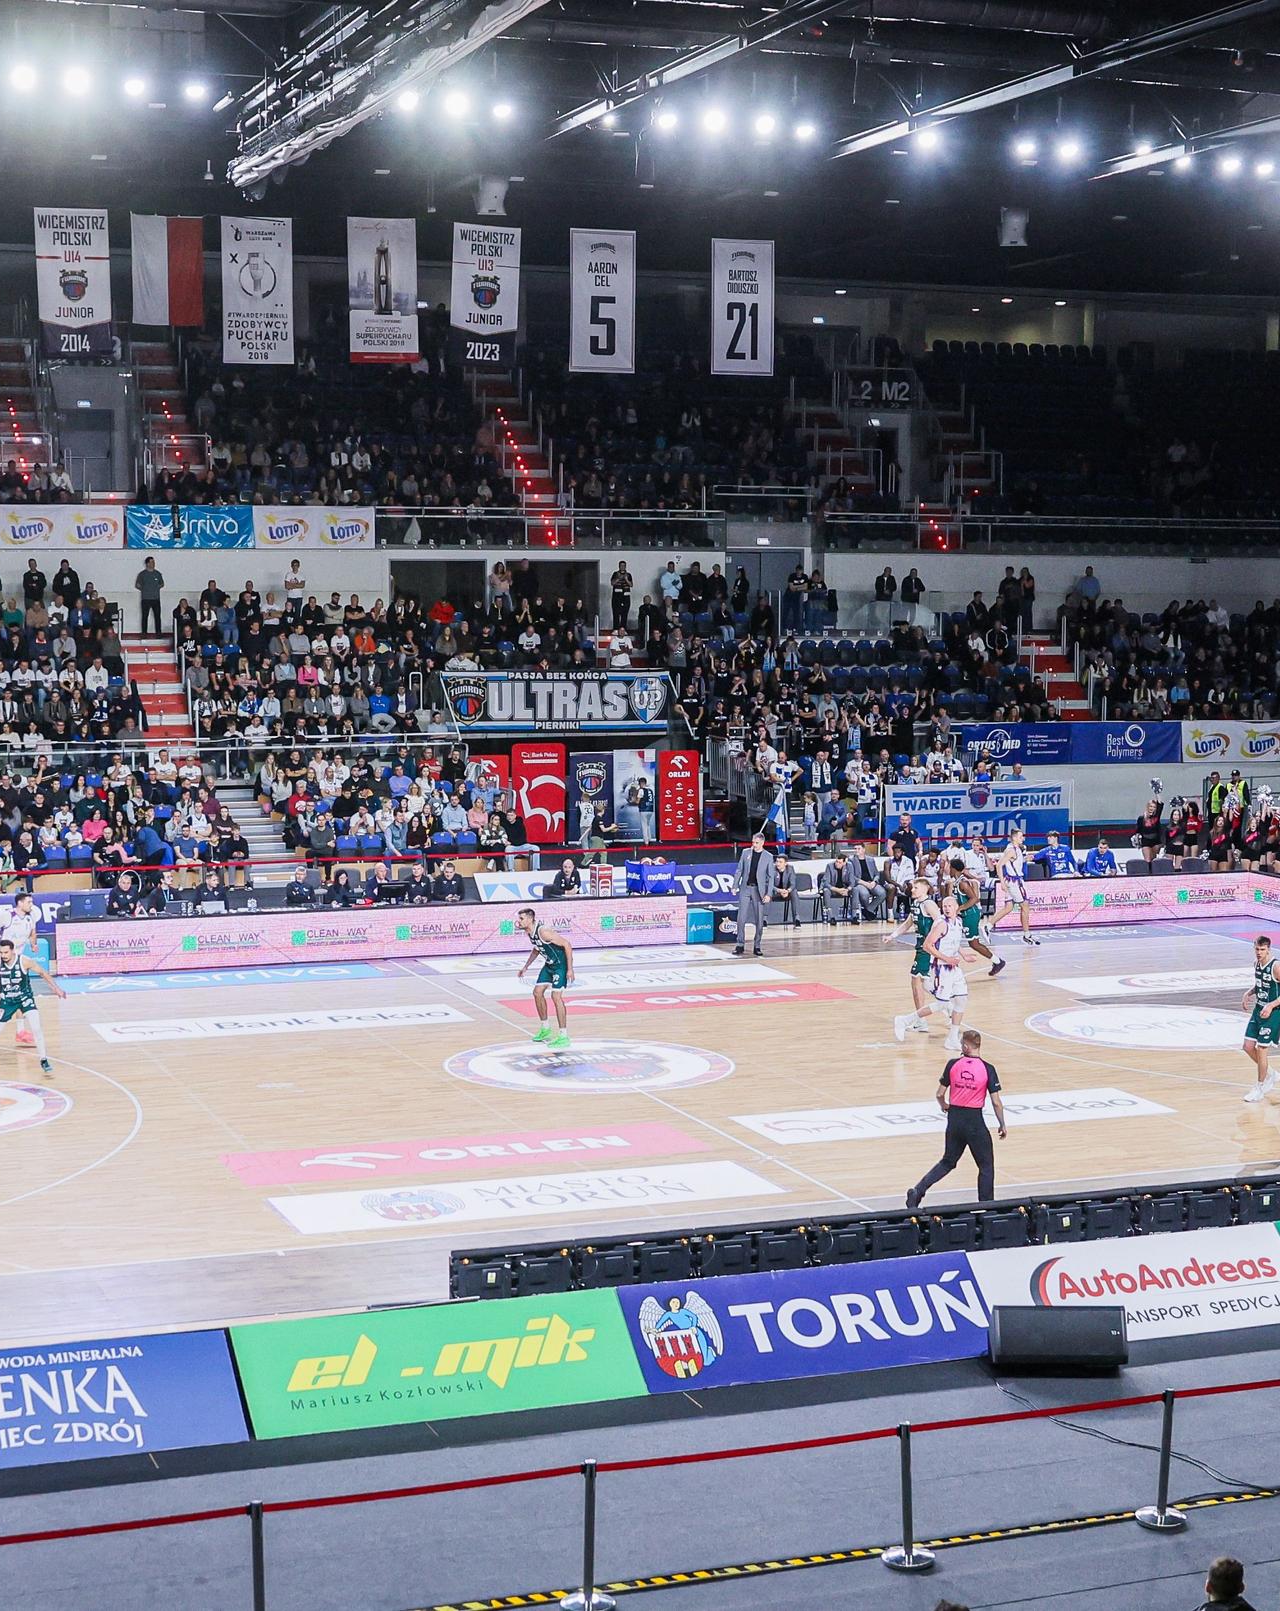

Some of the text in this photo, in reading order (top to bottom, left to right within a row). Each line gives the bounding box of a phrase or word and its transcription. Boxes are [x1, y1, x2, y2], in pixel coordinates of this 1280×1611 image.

[38, 214, 105, 230] WICEMISTRZ
[52, 231, 92, 246] POLSKI
[460, 229, 515, 245] WICEMISTRZ
[64, 251, 81, 263] U14
[471, 244, 503, 257] POLSKI
[478, 259, 494, 271] U13
[587, 262, 618, 275] AARON
[595, 275, 611, 287] CEL
[728, 270, 758, 282] BARTOSZ
[55, 306, 94, 319] JUNIOR
[465, 312, 503, 326] JUNIOR
[227, 320, 288, 329] ZDOBYWCY
[589, 295, 616, 355] 5
[726, 302, 758, 360] 21
[61, 334, 90, 352] 2014
[227, 330, 288, 341] PUCHARU
[240, 341, 276, 350] POLSKI
[466, 341, 500, 361] 2023
[248, 351, 269, 360] 2018
[882, 382, 910, 400] M2
[11, 522, 44, 541] LOTTO
[77, 521, 108, 540] LOTTO
[268, 523, 300, 542] LOTTO
[330, 522, 361, 540] LOTTO
[507, 670, 608, 680] PASJA BEZ KOŃCA
[487, 680, 628, 721] ULTRAS
[535, 721, 580, 730] PIERNIKI
[1002, 739, 1021, 749] MED
[1106, 733, 1125, 746] Best
[1194, 738, 1222, 753] LOTTO
[1249, 737, 1276, 752] LOTTO
[1106, 745, 1143, 759] Polymers
[893, 792, 1061, 812] TWARDE PIERNIKI
[925, 813, 1027, 847] TORUŃ
[647, 873, 672, 881] molten
[1051, 895, 1069, 903] WAY
[1105, 891, 1154, 901] CLEAN WAY
[1189, 888, 1235, 897] CLEAN WAY
[552, 917, 572, 927] WAY
[615, 912, 672, 923] CLEAN WAY
[306, 927, 368, 938] CLEAN WAY
[410, 922, 469, 932] CLEAN WAY
[85, 937, 150, 948] CLEAN WAY
[197, 932, 261, 944] CLEAN WAY
[166, 966, 351, 984] arriva
[643, 989, 798, 1004] ORLEN
[214, 1005, 450, 1031] Bank Pekao
[418, 1135, 631, 1161] ORLEN
[473, 1175, 648, 1196] MIASTO
[484, 1179, 695, 1210] TORUŃ
[1059, 1254, 1278, 1301] AutoAndreas
[728, 1269, 991, 1355] TORUŃ
[47, 1346, 144, 1366] MINERALNA
[289, 1380, 485, 1411] Mariusz Kozłowski
[53, 1418, 144, 1448] ZDRÓJ
